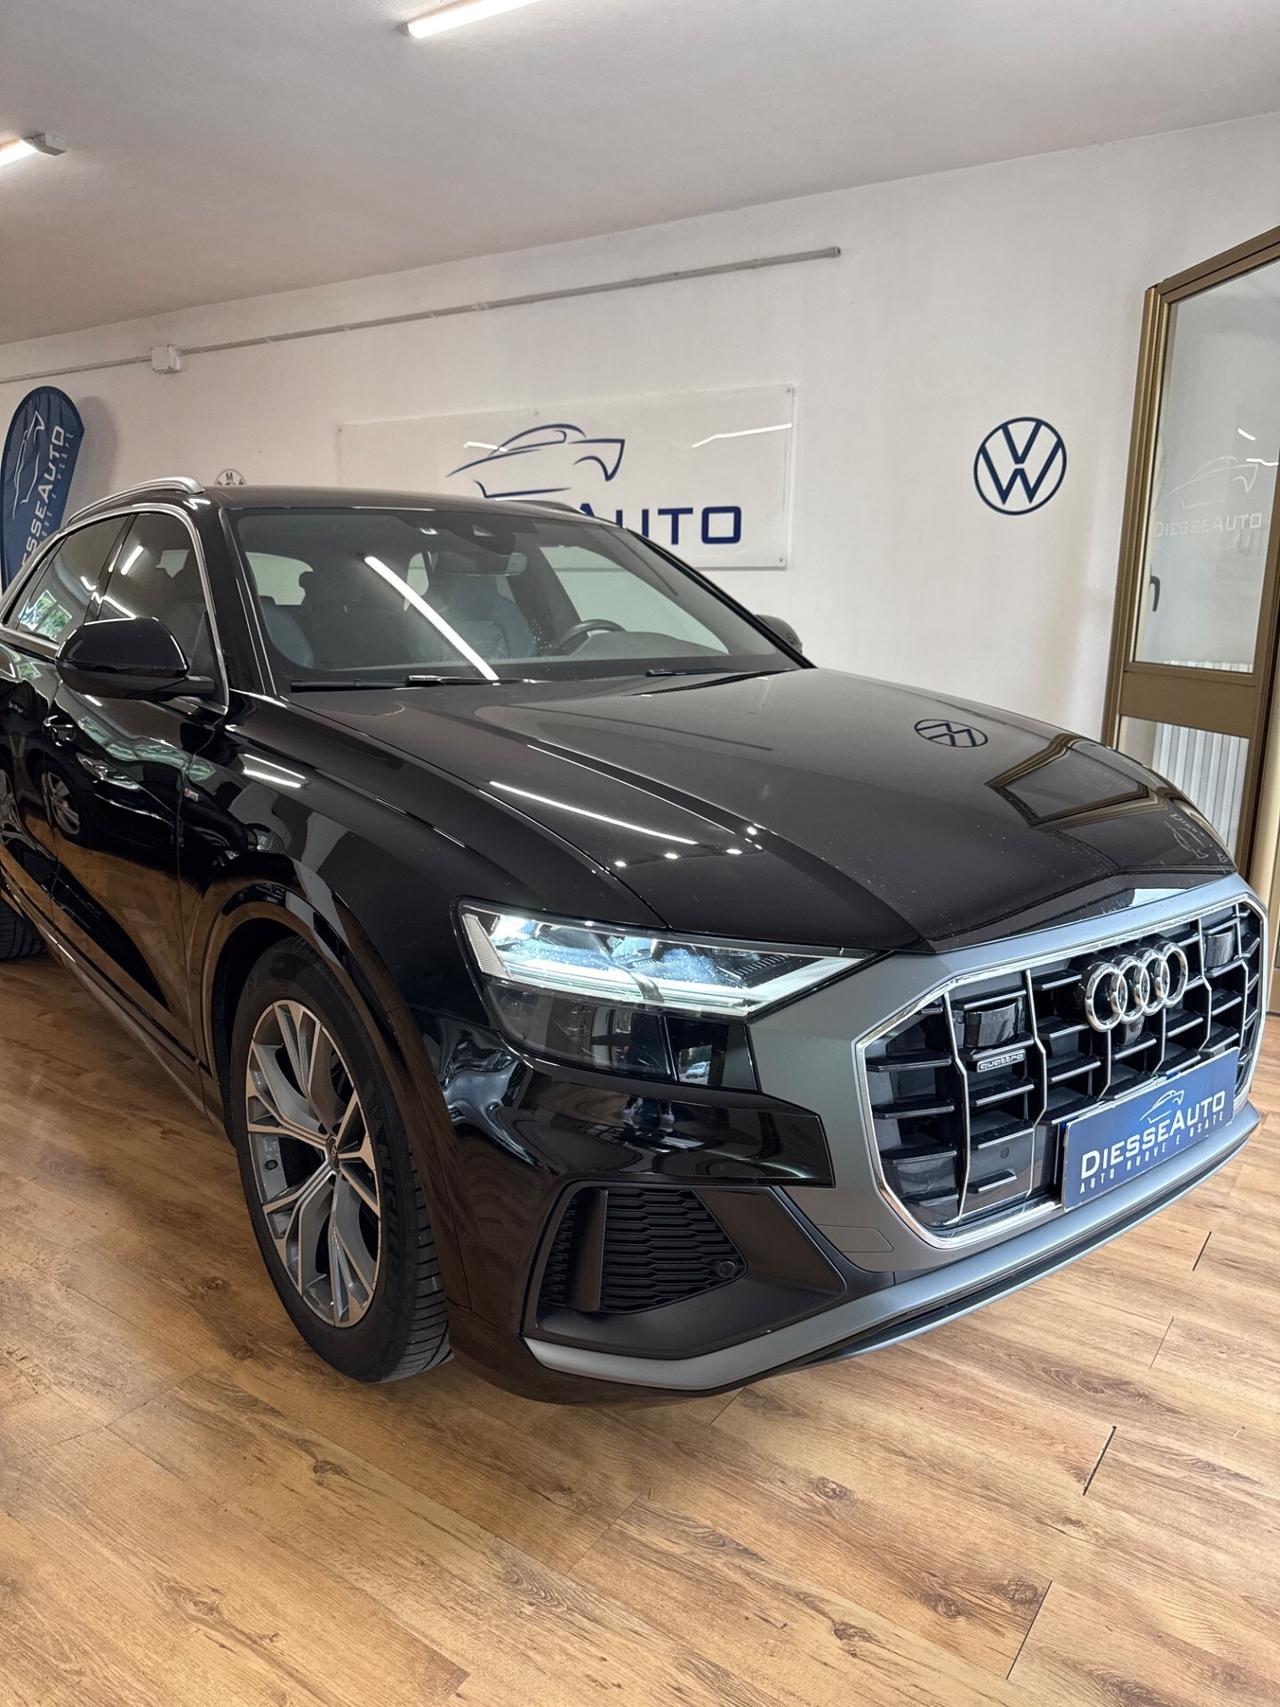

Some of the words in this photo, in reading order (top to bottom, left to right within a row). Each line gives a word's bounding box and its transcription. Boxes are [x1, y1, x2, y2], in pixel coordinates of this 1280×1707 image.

[1155, 513, 1263, 537] DIESSEAUTO
[980, 1053, 1024, 1069] quattro
[1080, 1168, 1114, 1194] AUTO
[1189, 1111, 1223, 1138] USATE
[1081, 1090, 1225, 1179] DIESSEAUTO
